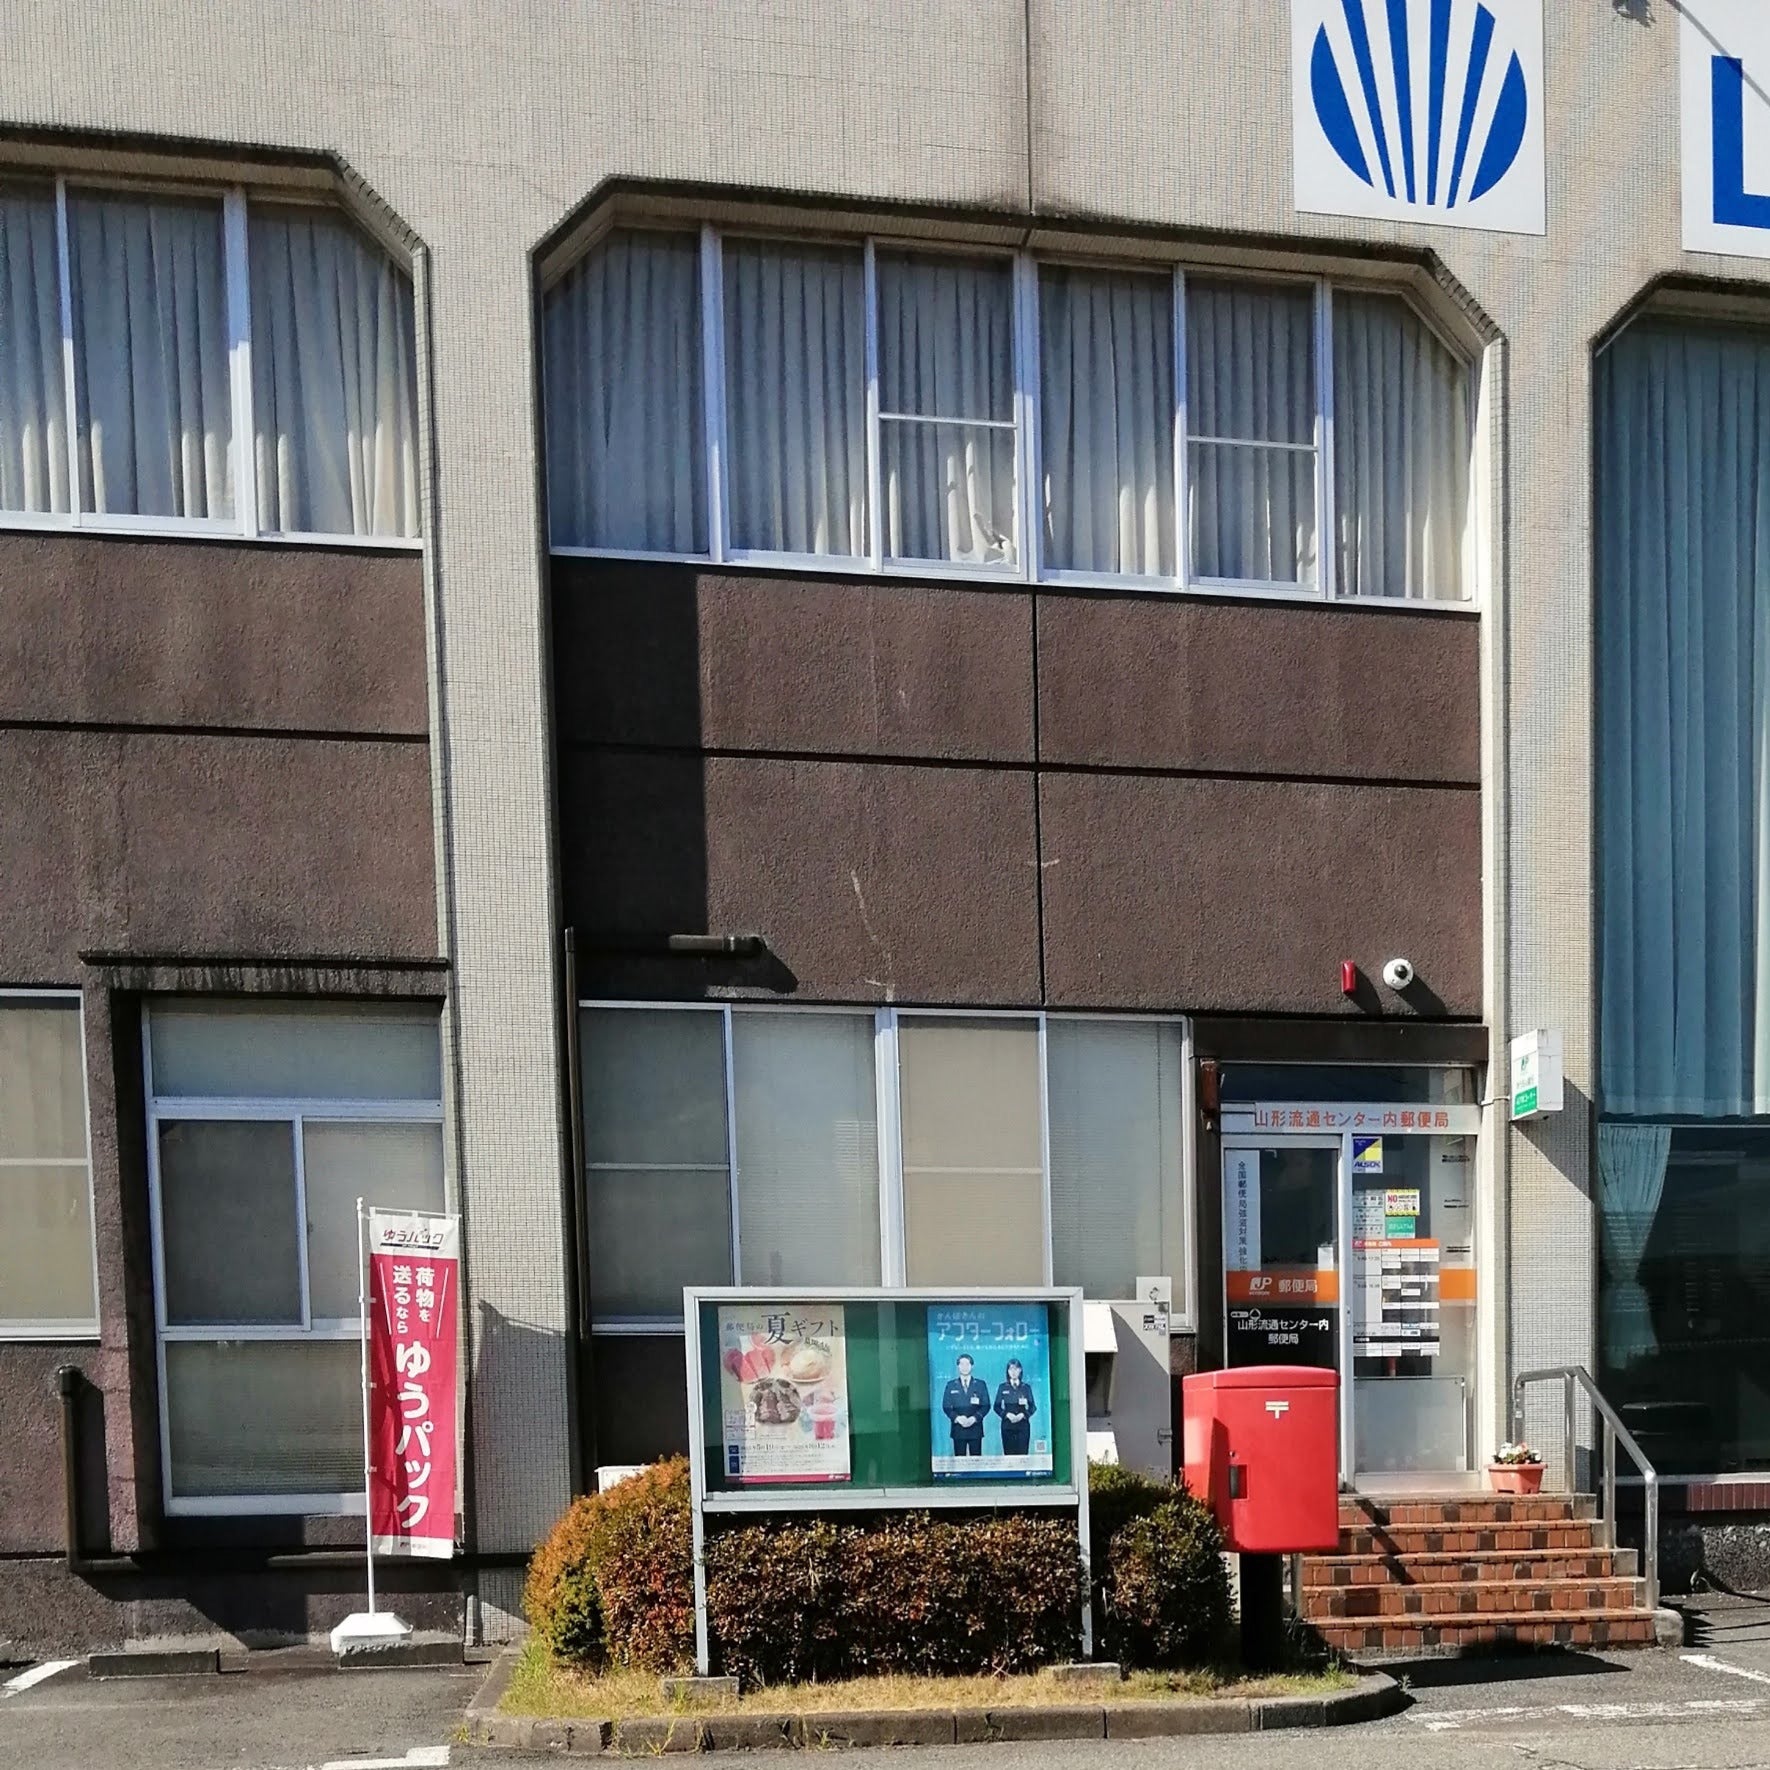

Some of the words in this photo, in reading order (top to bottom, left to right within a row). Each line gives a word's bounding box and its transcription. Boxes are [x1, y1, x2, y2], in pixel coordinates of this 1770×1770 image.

[1254, 1110, 1449, 1128] 山形流通センター内郵便局
[1387, 1195, 1398, 1203] NO
[415, 1265, 435, 1323] 荷物を
[1278, 1278, 1318, 1293] 郵便局
[392, 1265, 412, 1335] 送るなら
[936, 1322, 1040, 1342] アフターフォロー
[1237, 1319, 1329, 1331] 山形流通センター内
[1268, 1333, 1299, 1345] 郵便局
[395, 1341, 434, 1528] ゆうパック
